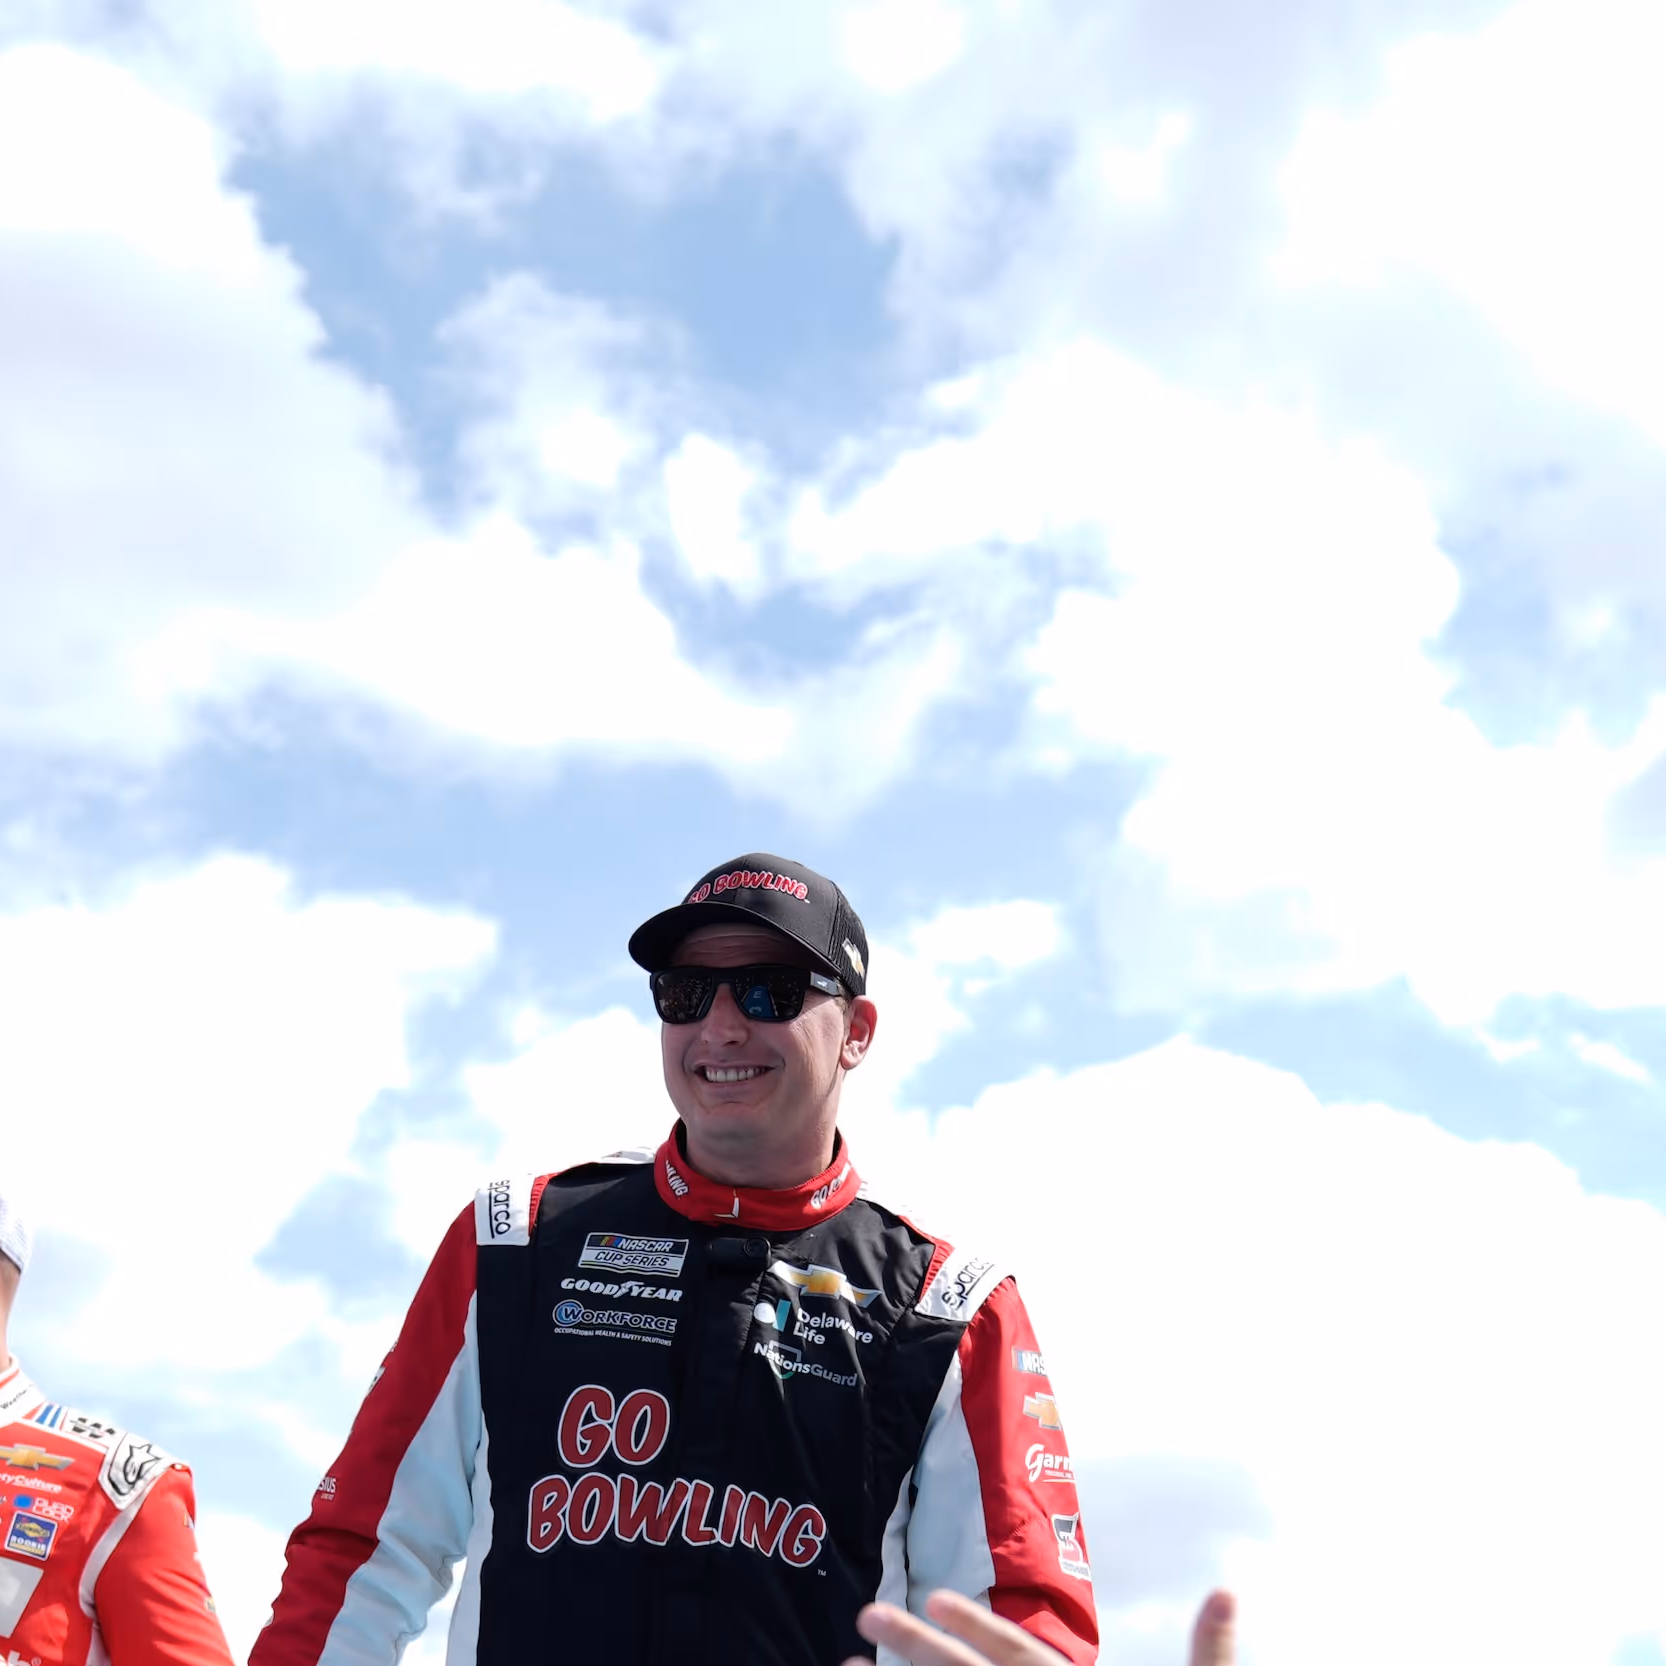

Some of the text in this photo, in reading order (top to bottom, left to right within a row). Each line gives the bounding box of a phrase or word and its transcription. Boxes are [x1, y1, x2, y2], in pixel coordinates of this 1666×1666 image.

[713, 870, 809, 900] BOWLING
[618, 1238, 674, 1252] NASCAR
[595, 1251, 670, 1267] CUP SERIES
[560, 1278, 683, 1302] GOODYEAR
[561, 1305, 678, 1333] WORKFORCE
[797, 1308, 873, 1344] Delaware
[595, 1329, 616, 1339] HEALTH
[621, 1332, 642, 1342] SAFETY
[642, 1335, 672, 1346] SOLUTIONS
[793, 1322, 825, 1345] Life
[753, 1342, 858, 1387] NationsGuard
[557, 1384, 670, 1468] GO
[527, 1472, 827, 1568] BOWLING
[10, 1535, 47, 1551] ROOKIE
